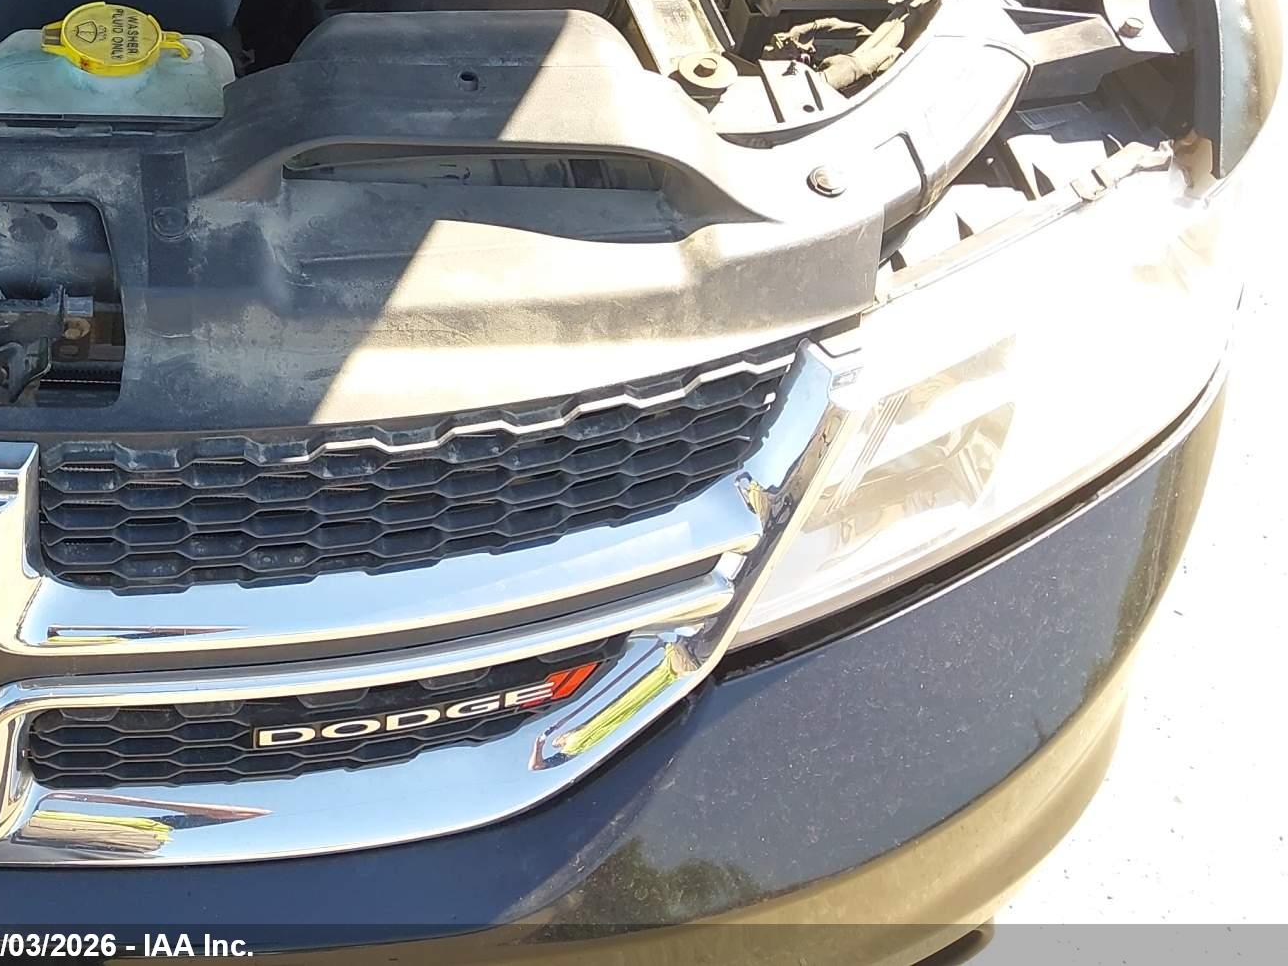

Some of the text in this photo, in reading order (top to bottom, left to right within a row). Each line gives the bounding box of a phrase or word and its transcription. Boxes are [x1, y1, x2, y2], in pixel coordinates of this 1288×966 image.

[111, 8, 124, 60] FLUID ONLY
[126, 15, 139, 54] WASHER
[258, 681, 555, 748] DODGE
